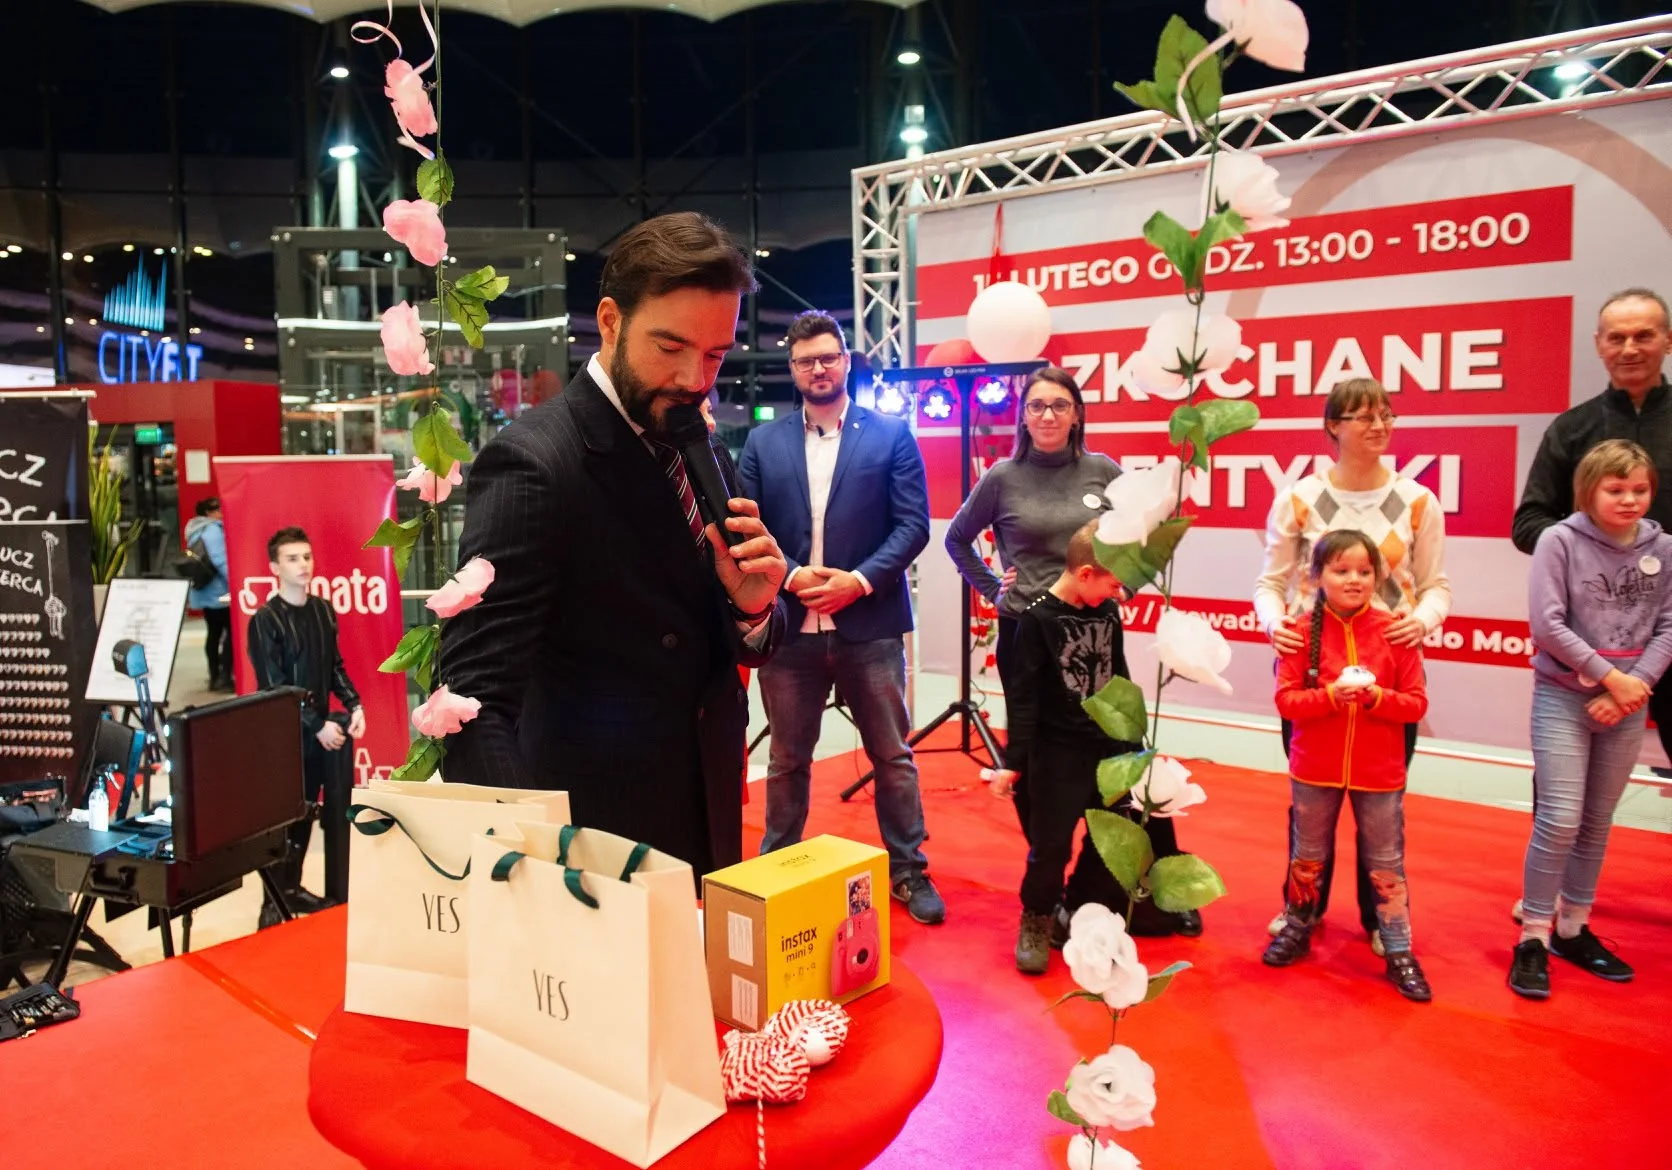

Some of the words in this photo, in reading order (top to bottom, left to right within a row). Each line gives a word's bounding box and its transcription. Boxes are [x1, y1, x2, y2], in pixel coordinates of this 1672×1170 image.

[1273, 229, 1374, 268] 13:00
[1386, 237, 1401, 245] -
[1412, 212, 1531, 254] 18:00
[422, 893, 460, 934] YES
[781, 927, 818, 953] instax
[786, 948, 806, 963] mini
[808, 943, 814, 954] 9
[533, 969, 569, 1022] YES
